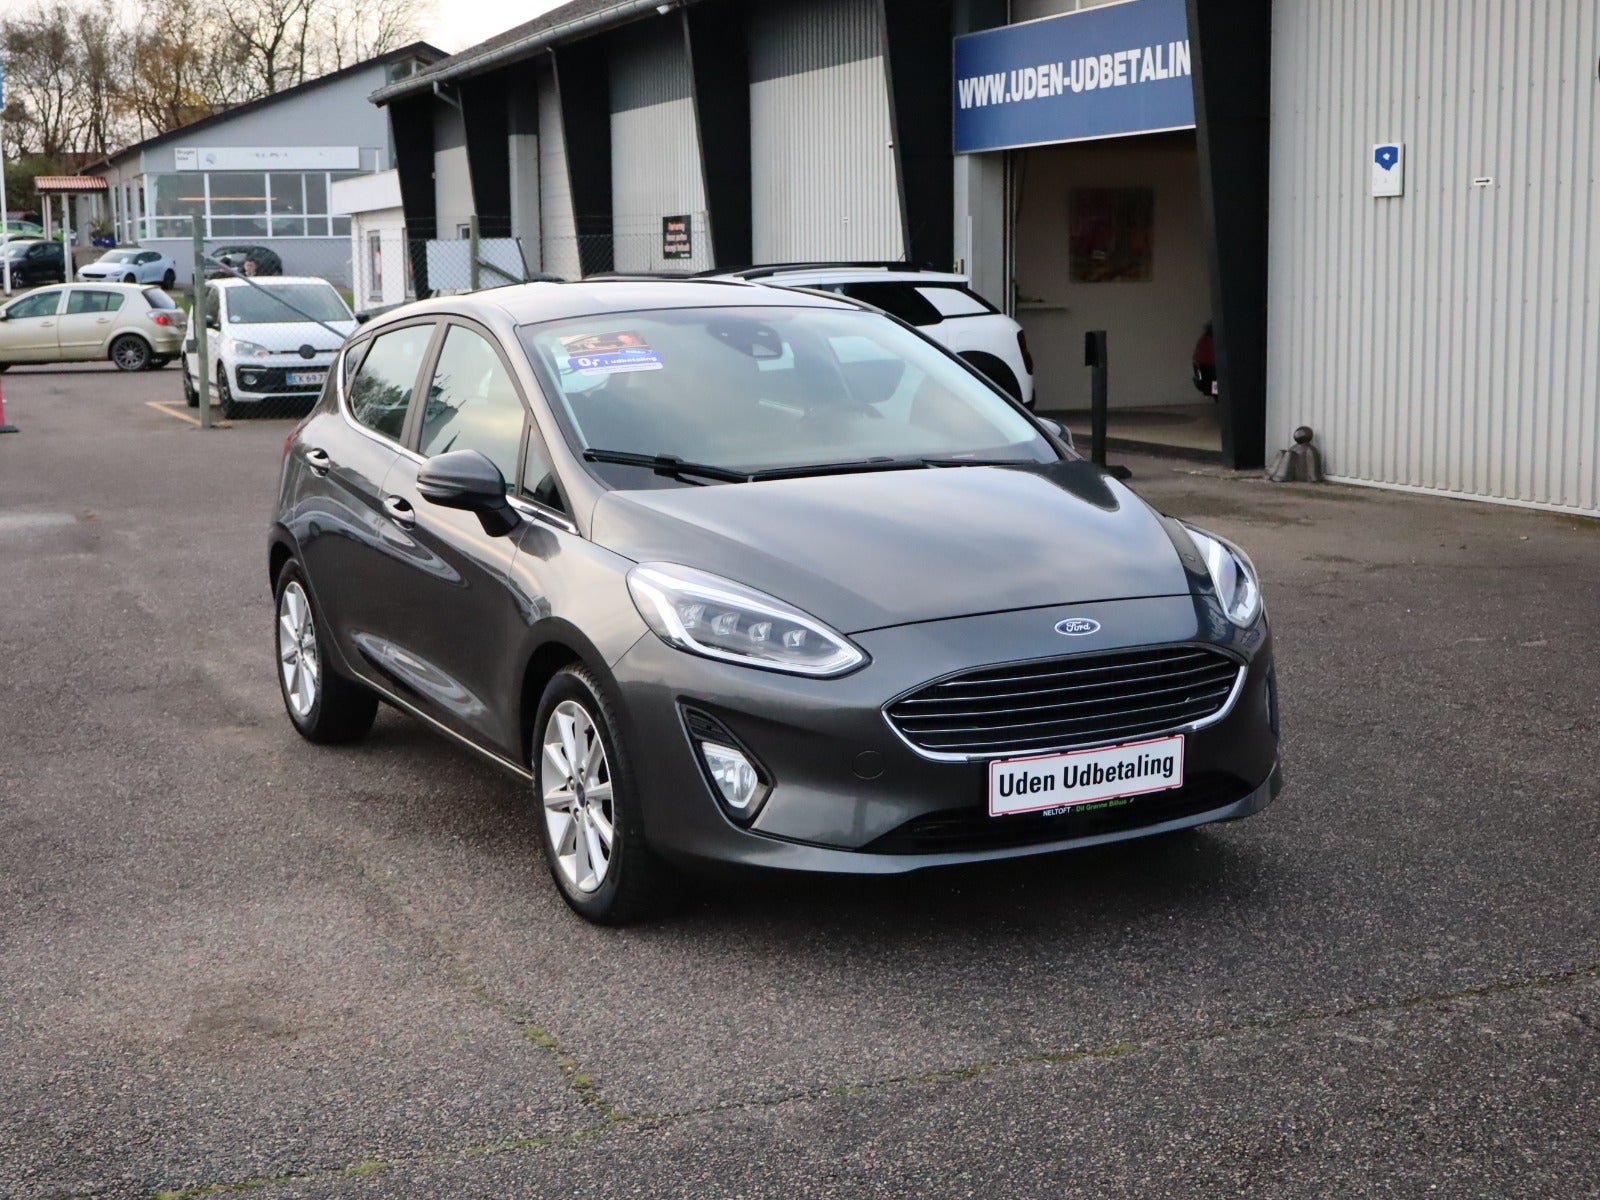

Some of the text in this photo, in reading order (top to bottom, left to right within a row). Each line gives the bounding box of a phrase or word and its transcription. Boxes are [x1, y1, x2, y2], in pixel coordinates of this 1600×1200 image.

[1066, 620, 1091, 632] Ford
[1000, 753, 1175, 798] Uden Udbetaling
[1042, 806, 1071, 817] NELTOFT
